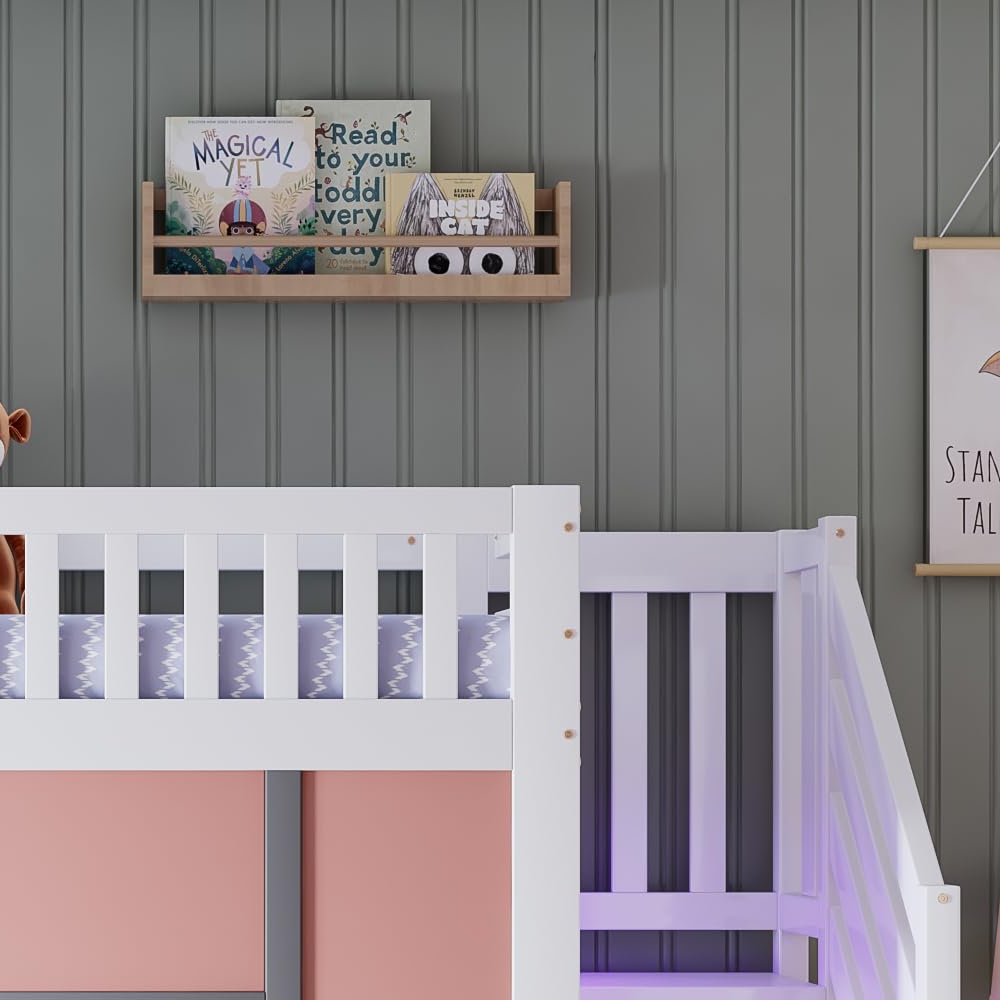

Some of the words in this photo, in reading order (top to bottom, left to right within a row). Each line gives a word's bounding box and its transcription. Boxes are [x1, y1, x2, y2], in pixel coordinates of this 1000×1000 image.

[201, 128, 217, 141] THE
[332, 121, 397, 145] Read
[192, 134, 294, 170] MAGICAL
[315, 147, 341, 169] to
[352, 152, 410, 175] your
[220, 158, 264, 186] YET
[429, 197, 505, 220] INSIDE
[315, 209, 382, 233] very
[440, 217, 490, 236] CAT
